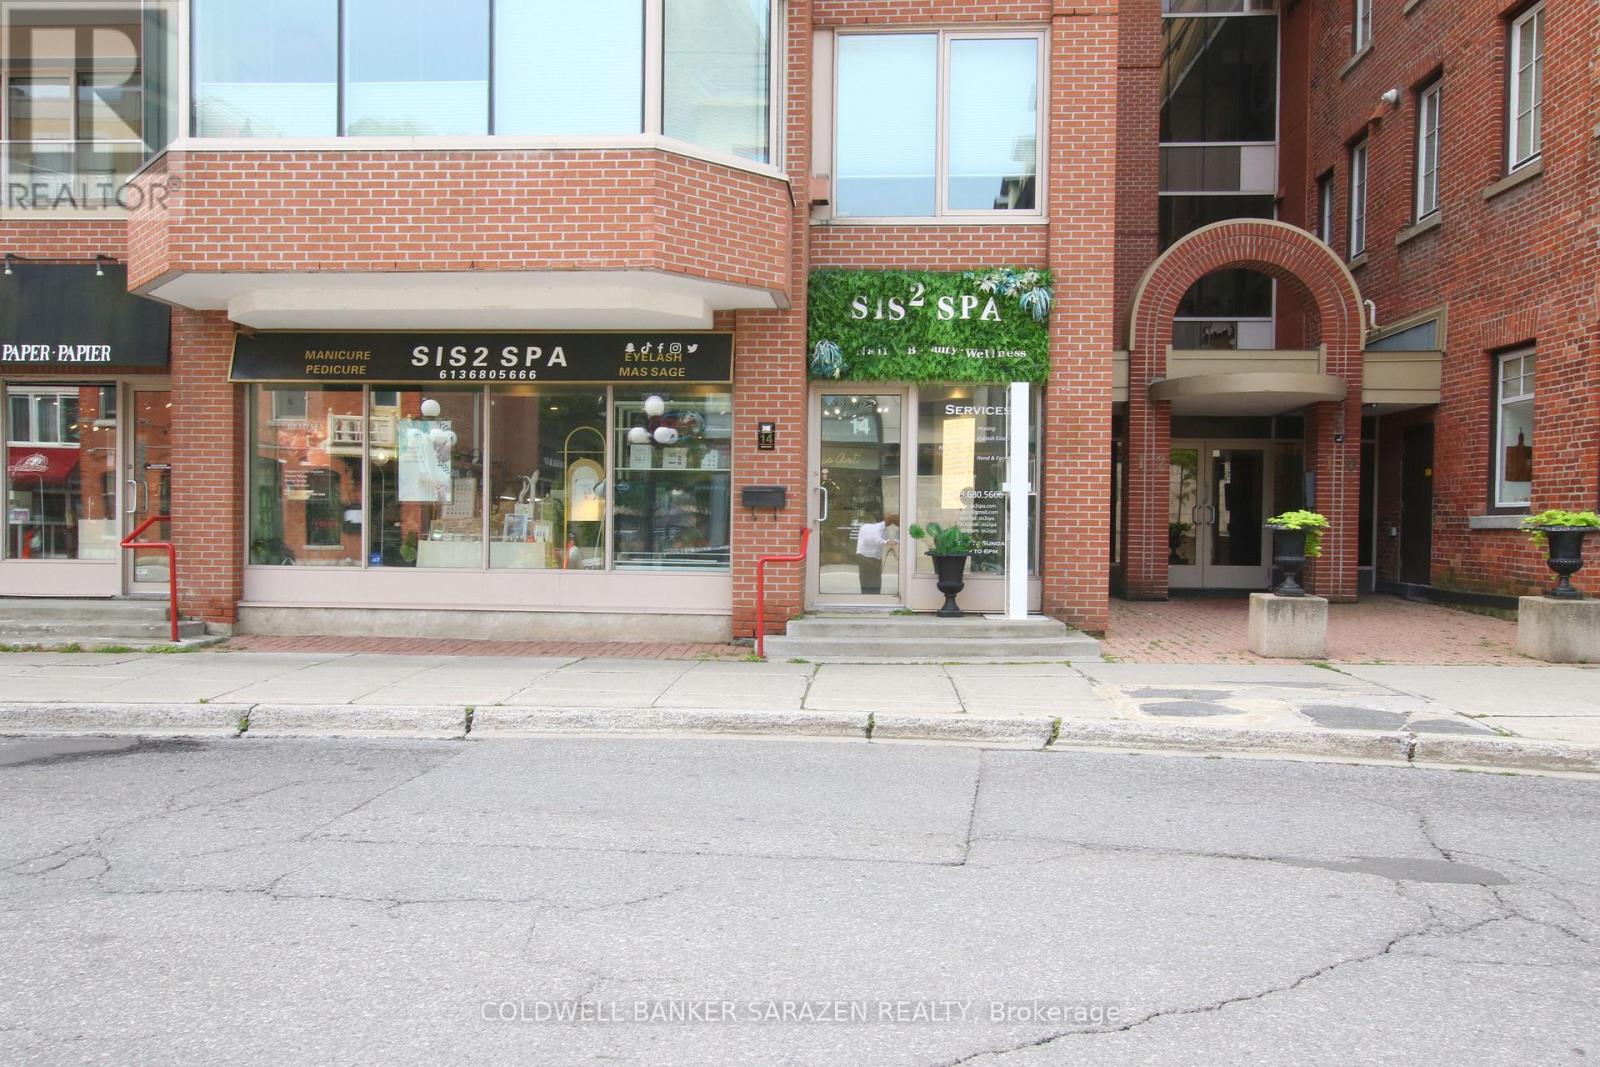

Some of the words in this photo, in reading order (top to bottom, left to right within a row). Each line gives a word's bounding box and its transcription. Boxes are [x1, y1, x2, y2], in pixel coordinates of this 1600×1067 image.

[937, 294, 1002, 322] SPA
[2, 344, 51, 362] PAPER
[57, 344, 112, 362] PAPIER
[304, 350, 372, 361] MANICURE
[410, 345, 489, 367] SIS2
[500, 345, 568, 367] SPA
[624, 351, 683, 363] EYELASH
[965, 347, 1027, 359] Wellness
[305, 364, 367, 375] PEDICURE
[438, 368, 538, 380] 6136805666
[759, 433, 773, 444] 14
